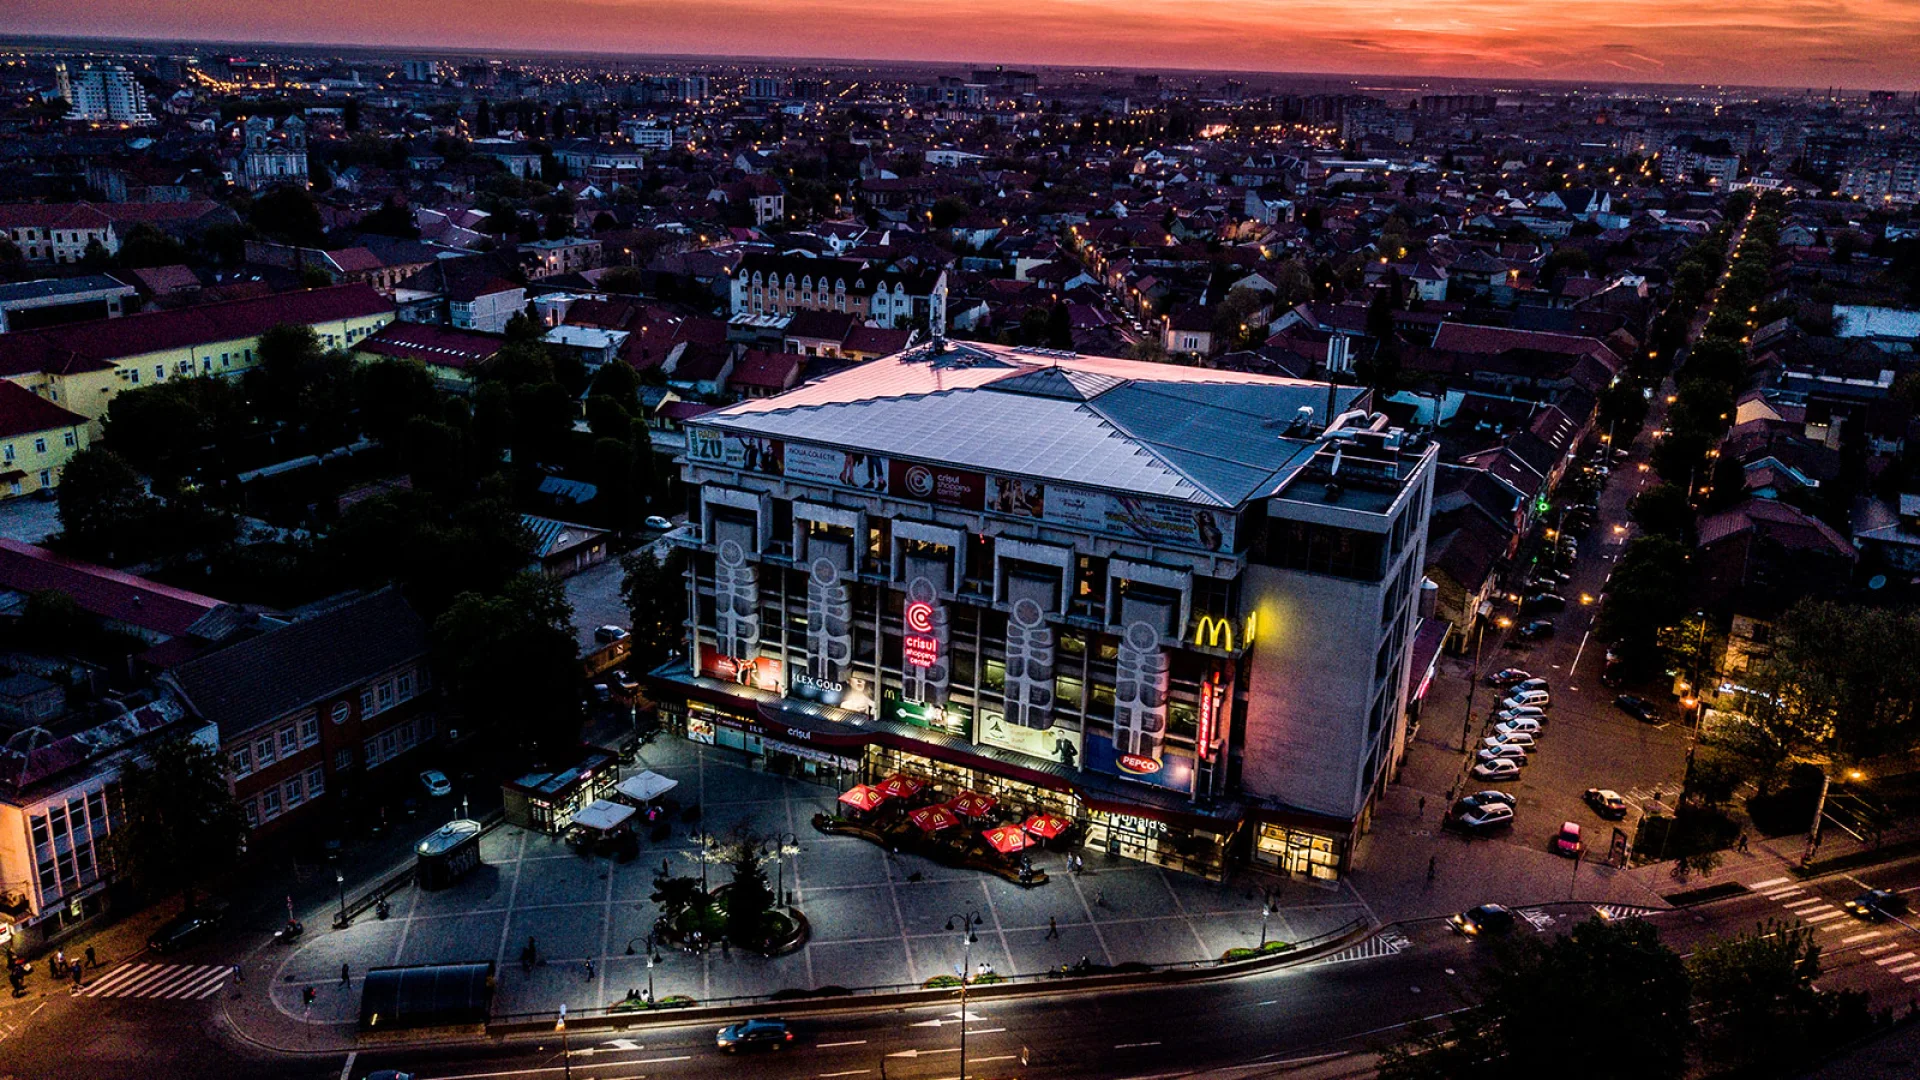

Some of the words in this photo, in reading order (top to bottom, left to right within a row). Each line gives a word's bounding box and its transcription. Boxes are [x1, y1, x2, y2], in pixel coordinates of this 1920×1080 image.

[700, 439, 722, 458] ZU
[937, 473, 960, 484] crisul
[906, 637, 937, 652] crisul
[905, 648, 938, 663] shopping
[909, 657, 931, 667] center
[815, 678, 842, 692] GOLD
[786, 727, 812, 741] crisul
[1122, 755, 1156, 771] PEPCO
